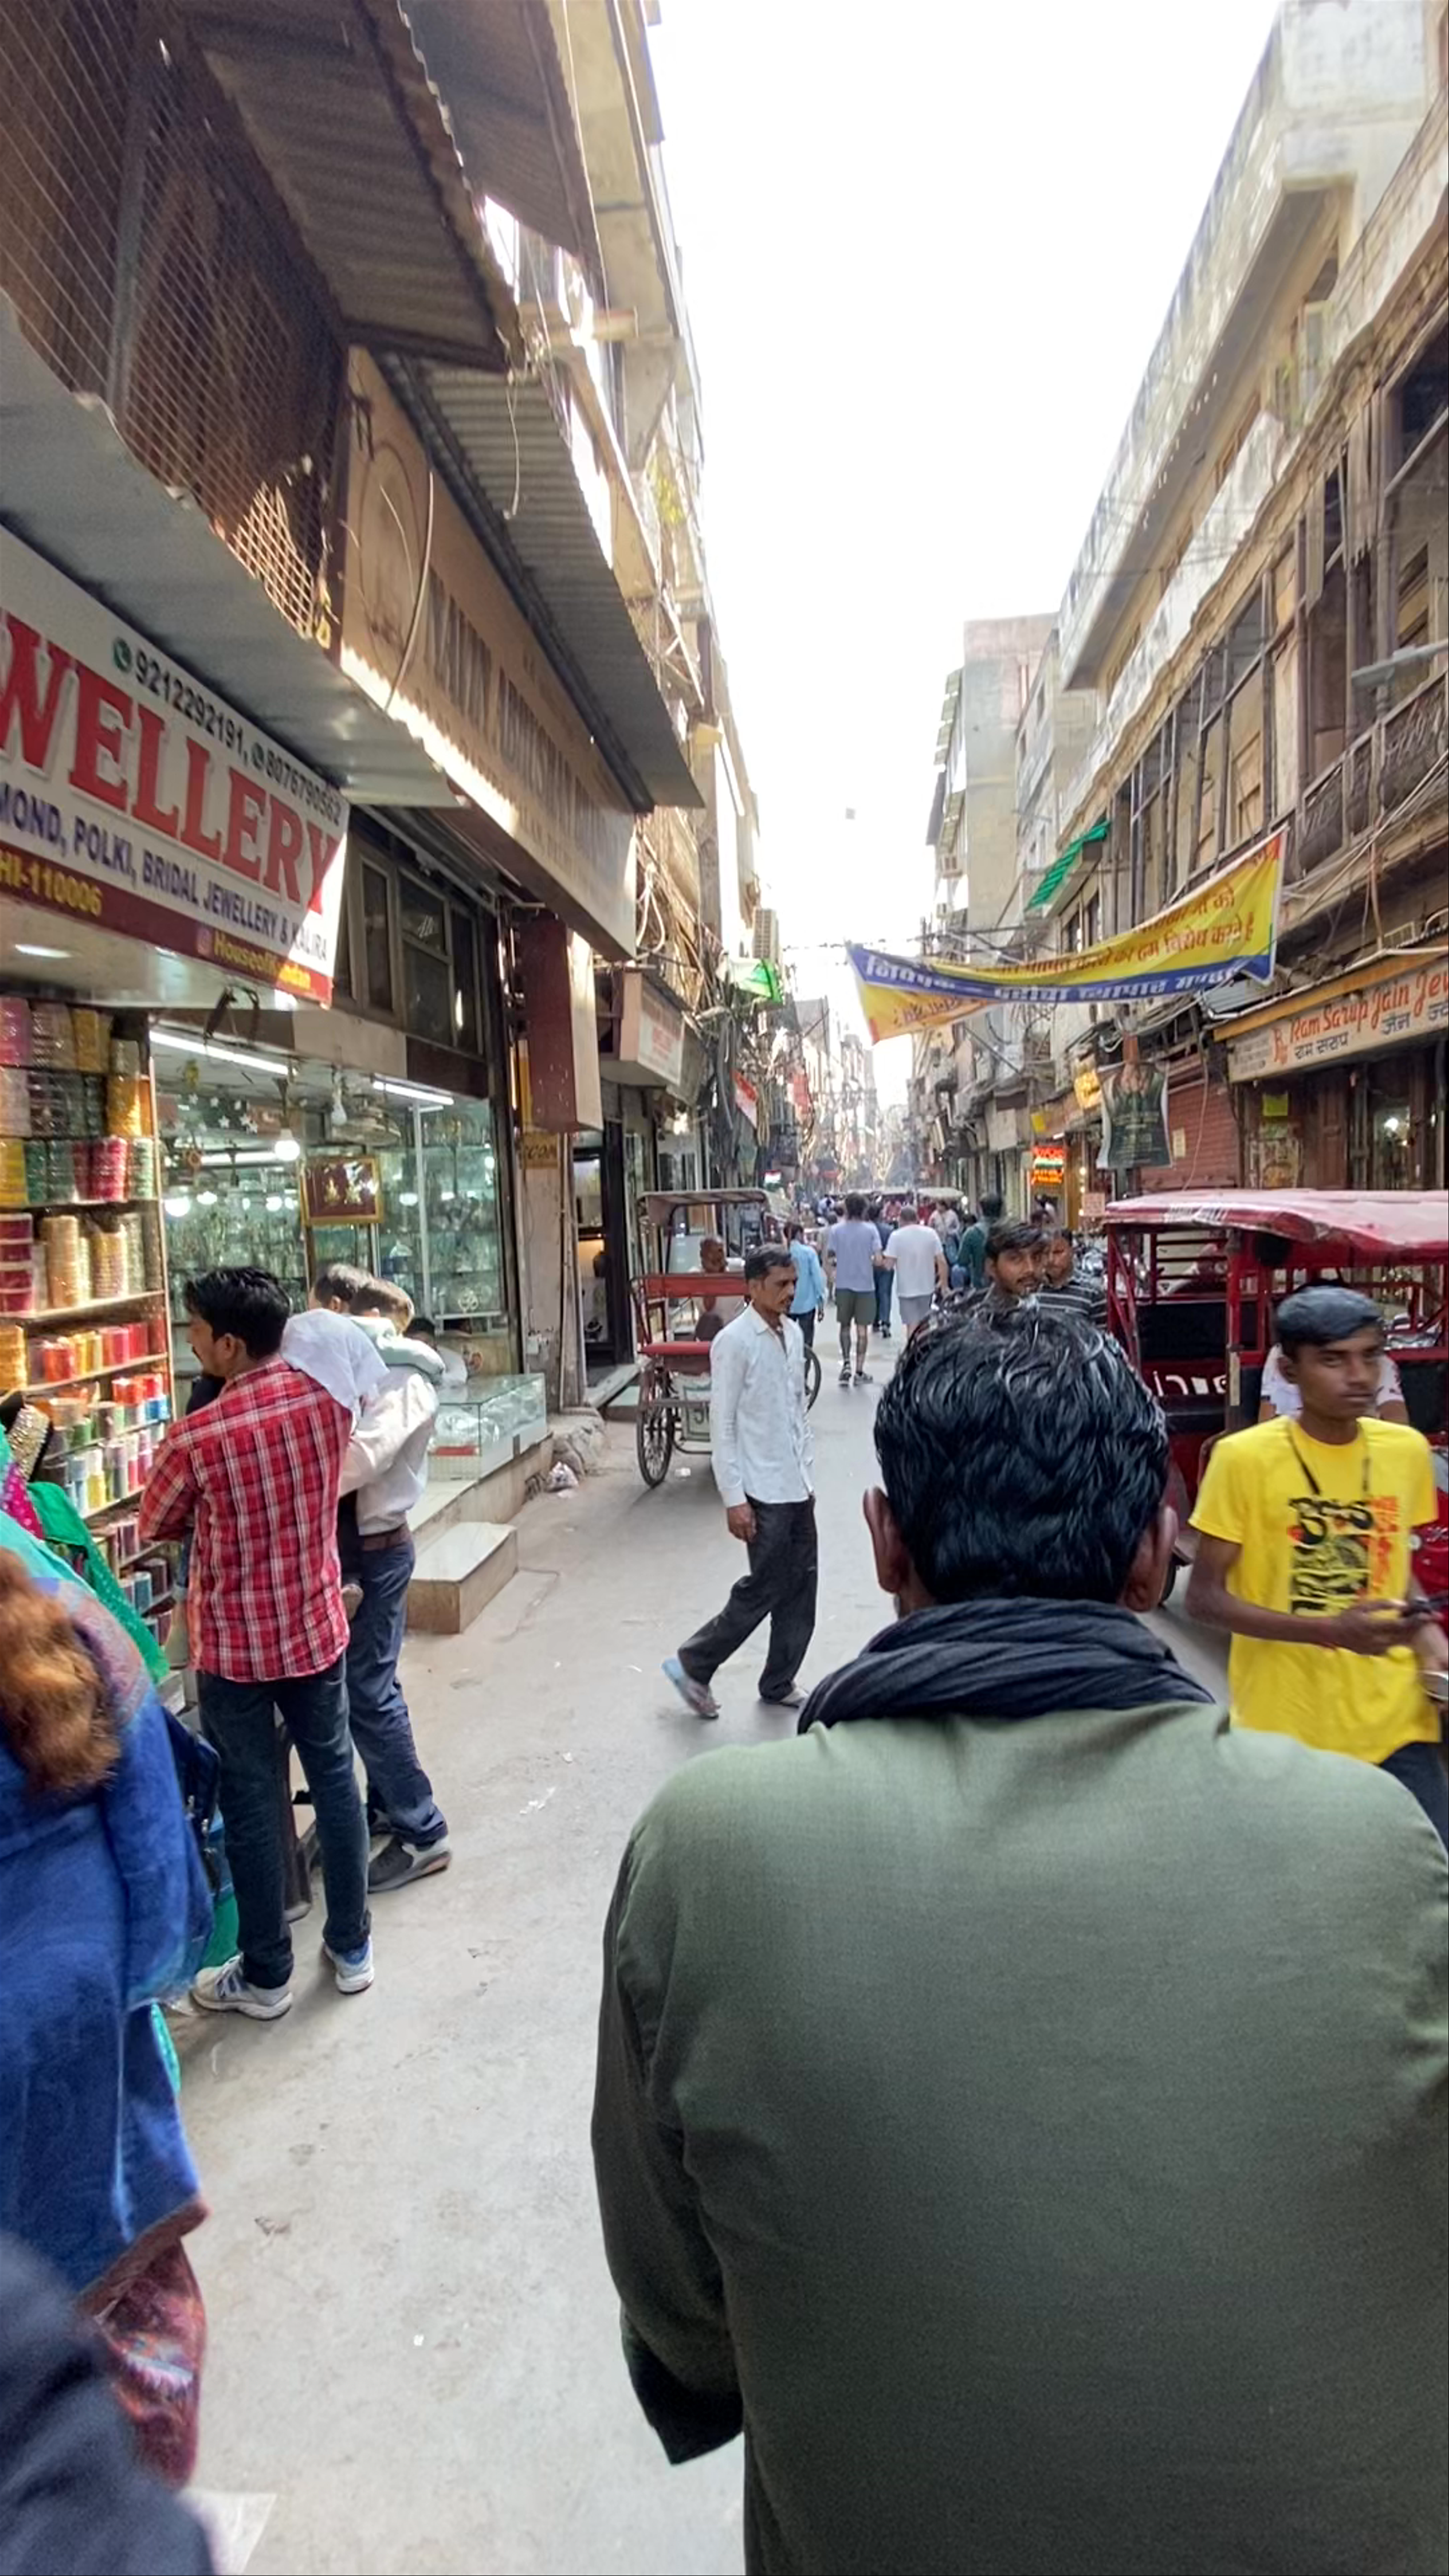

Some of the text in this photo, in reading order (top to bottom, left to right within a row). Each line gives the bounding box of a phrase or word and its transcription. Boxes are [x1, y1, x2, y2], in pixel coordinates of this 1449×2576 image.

[136, 649, 249, 765] 9212292191,
[75, 815, 137, 889] POLKI,
[143, 848, 198, 905] BRIDAL
[204, 880, 278, 940] JEWELLERY
[1289, 1017, 1321, 1044] Ram
[1323, 1003, 1369, 1033] Sarup
[1371, 982, 1409, 1030] Jain
